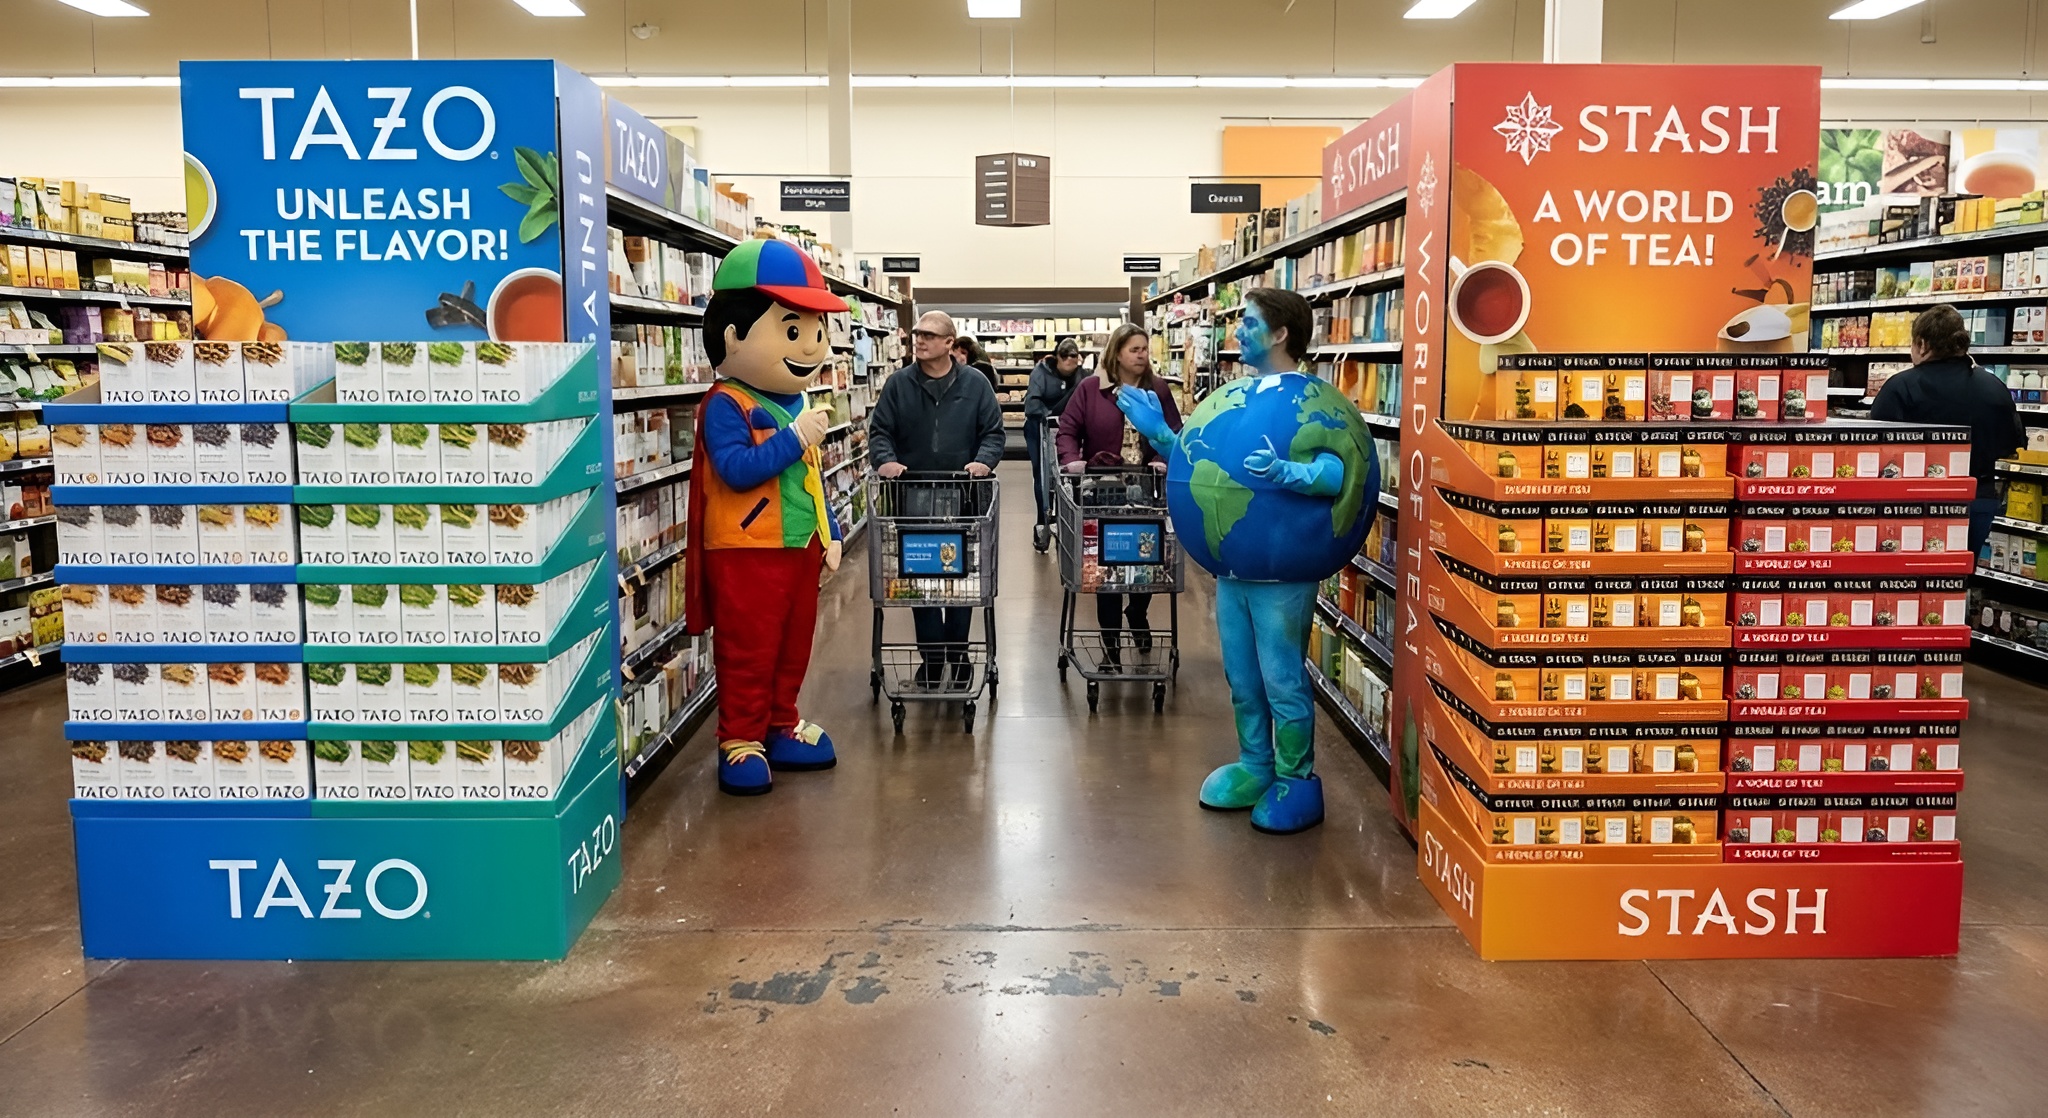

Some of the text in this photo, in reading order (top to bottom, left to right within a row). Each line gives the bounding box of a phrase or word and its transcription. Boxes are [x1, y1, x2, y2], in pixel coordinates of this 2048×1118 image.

[239, 85, 496, 162] TAZO
[615, 118, 661, 188] TAZO
[1578, 105, 1781, 155] STASH
[1347, 123, 1400, 192] STASH
[276, 188, 471, 222] UNLEASH
[1533, 190, 1734, 224] A WORLD
[240, 228, 509, 262] THE FLAVOR!
[1550, 233, 1714, 267] OF TEA!
[1412, 231, 1434, 435] WORLD
[1409, 450, 1426, 521] OF
[567, 813, 616, 896] TAZO
[1423, 829, 1475, 919] STASH
[208, 857, 429, 921] TAZO
[1618, 888, 1829, 936] STASH
